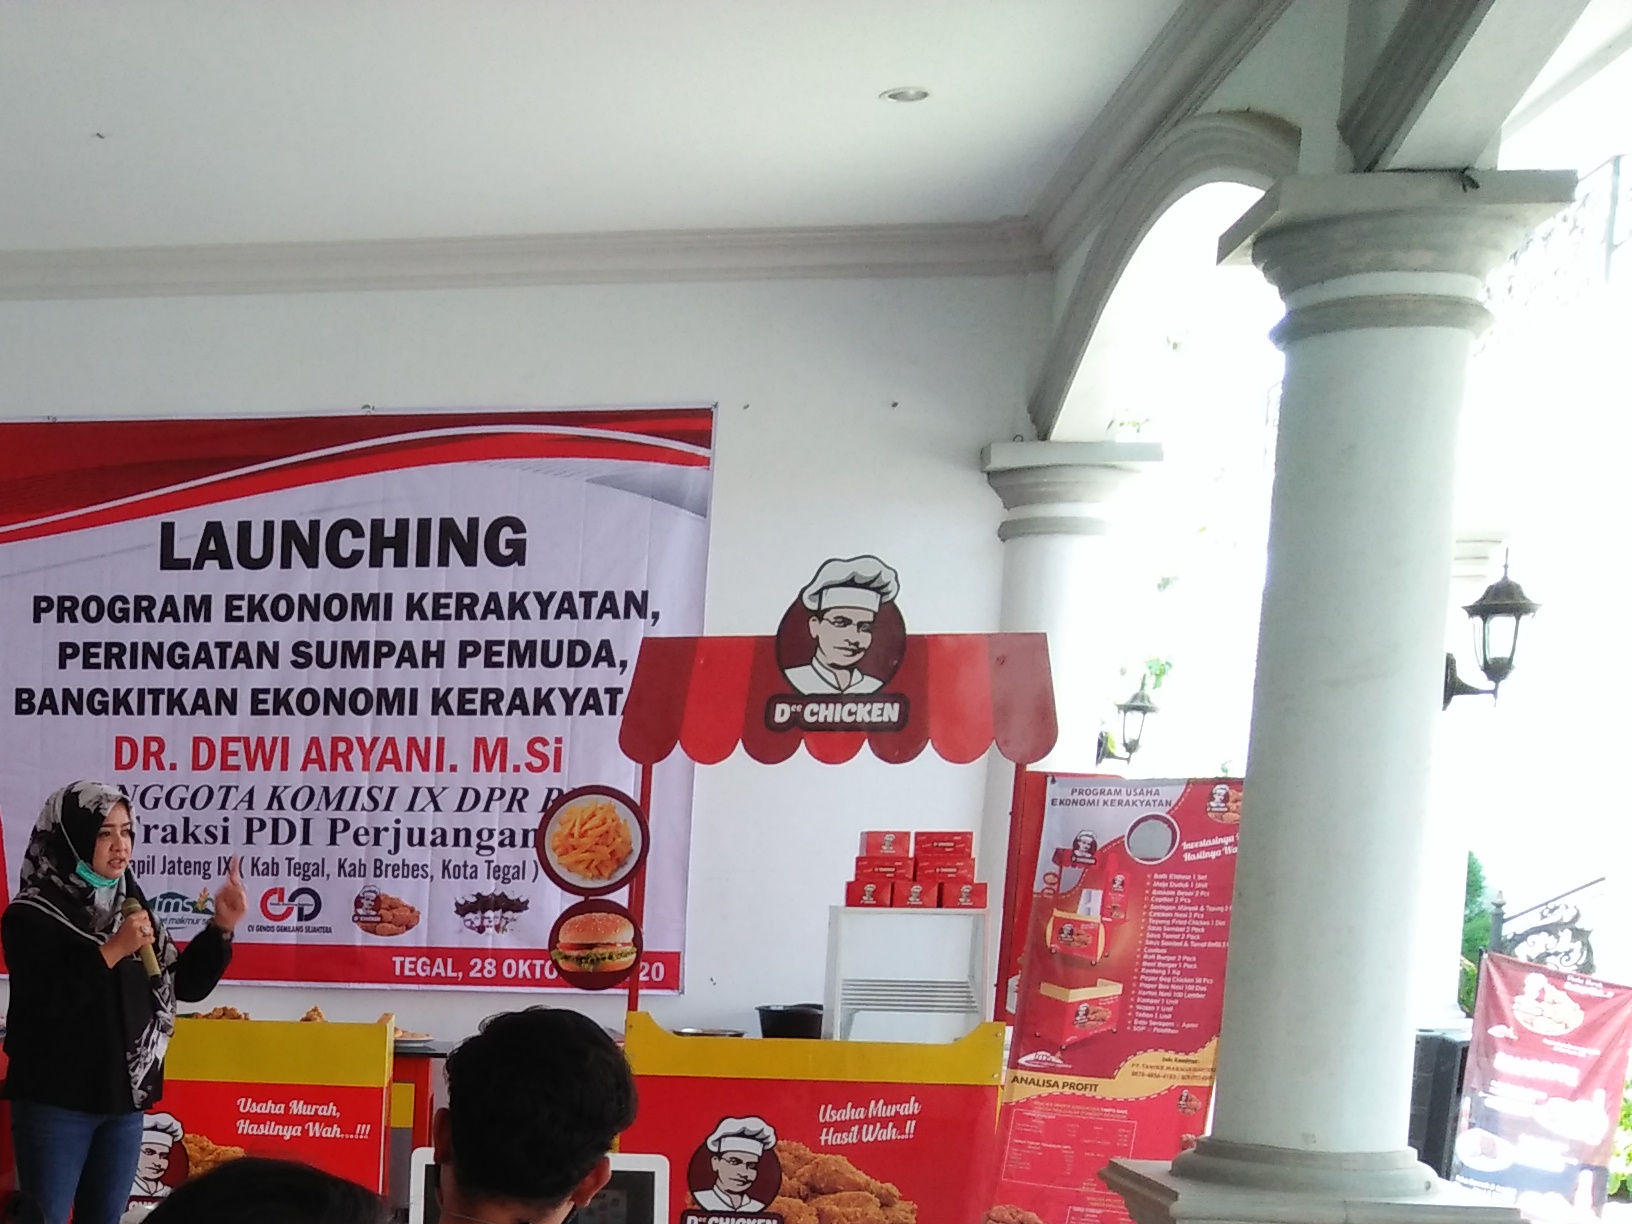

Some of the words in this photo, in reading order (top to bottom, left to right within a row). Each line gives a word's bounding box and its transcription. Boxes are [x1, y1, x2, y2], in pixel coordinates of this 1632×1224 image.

[160, 515, 528, 570] LAUNCHING
[32, 595, 212, 623] PROGRAM
[224, 592, 393, 621] EKONOMI
[405, 590, 661, 627] KERAKYATAN,
[58, 640, 279, 670] PERINGATAN
[290, 639, 445, 668] SUMPAH
[458, 639, 629, 675] PEMUDA,
[13, 688, 237, 716] BANGKITKAN
[250, 688, 420, 716] EKONOMI
[431, 686, 626, 716] KERAKYAT
[804, 703, 900, 723] CHICKEN
[114, 735, 177, 772] DR.
[191, 735, 289, 772] DEWI
[300, 735, 460, 773] ARYANI.
[472, 734, 564, 773] M.Si
[116, 783, 261, 813] NGGOTA
[269, 785, 395, 813] KOMISI
[404, 786, 452, 813] IX
[453, 786, 528, 813] DPR
[1051, 798, 1099, 806] EKONOMI
[1071, 788, 1122, 796] PROGRAM
[1126, 788, 1160, 796] USAHA
[136, 816, 231, 846] raksi
[242, 817, 311, 846] PDI
[328, 817, 538, 856] Perjuangan
[1183, 850, 1221, 862] Hasilnya
[1223, 846, 1238, 854] Wa
[129, 855, 156, 881] apil
[160, 856, 212, 882] Jateng
[250, 856, 280, 878] Kab
[285, 857, 331, 883] Tegal,
[337, 857, 366, 878] Kab
[373, 858, 434, 882] Brebes,
[441, 859, 479, 880] Kota
[484, 859, 526, 885] Tegal
[392, 956, 463, 980] TEGAL,
[469, 959, 496, 977] 28
[503, 958, 557, 978] OKTO
[639, 962, 664, 982] 20
[1011, 1076, 1059, 1088] ANALISA
[1061, 1081, 1099, 1092] PROFIT
[237, 1098, 285, 1114] Usaha
[289, 1100, 340, 1118] Murah,
[819, 1102, 866, 1123] Usaha
[868, 1096, 921, 1117] Murah
[236, 1119, 302, 1140] Hasilnya
[820, 1122, 860, 1146] Hasil
